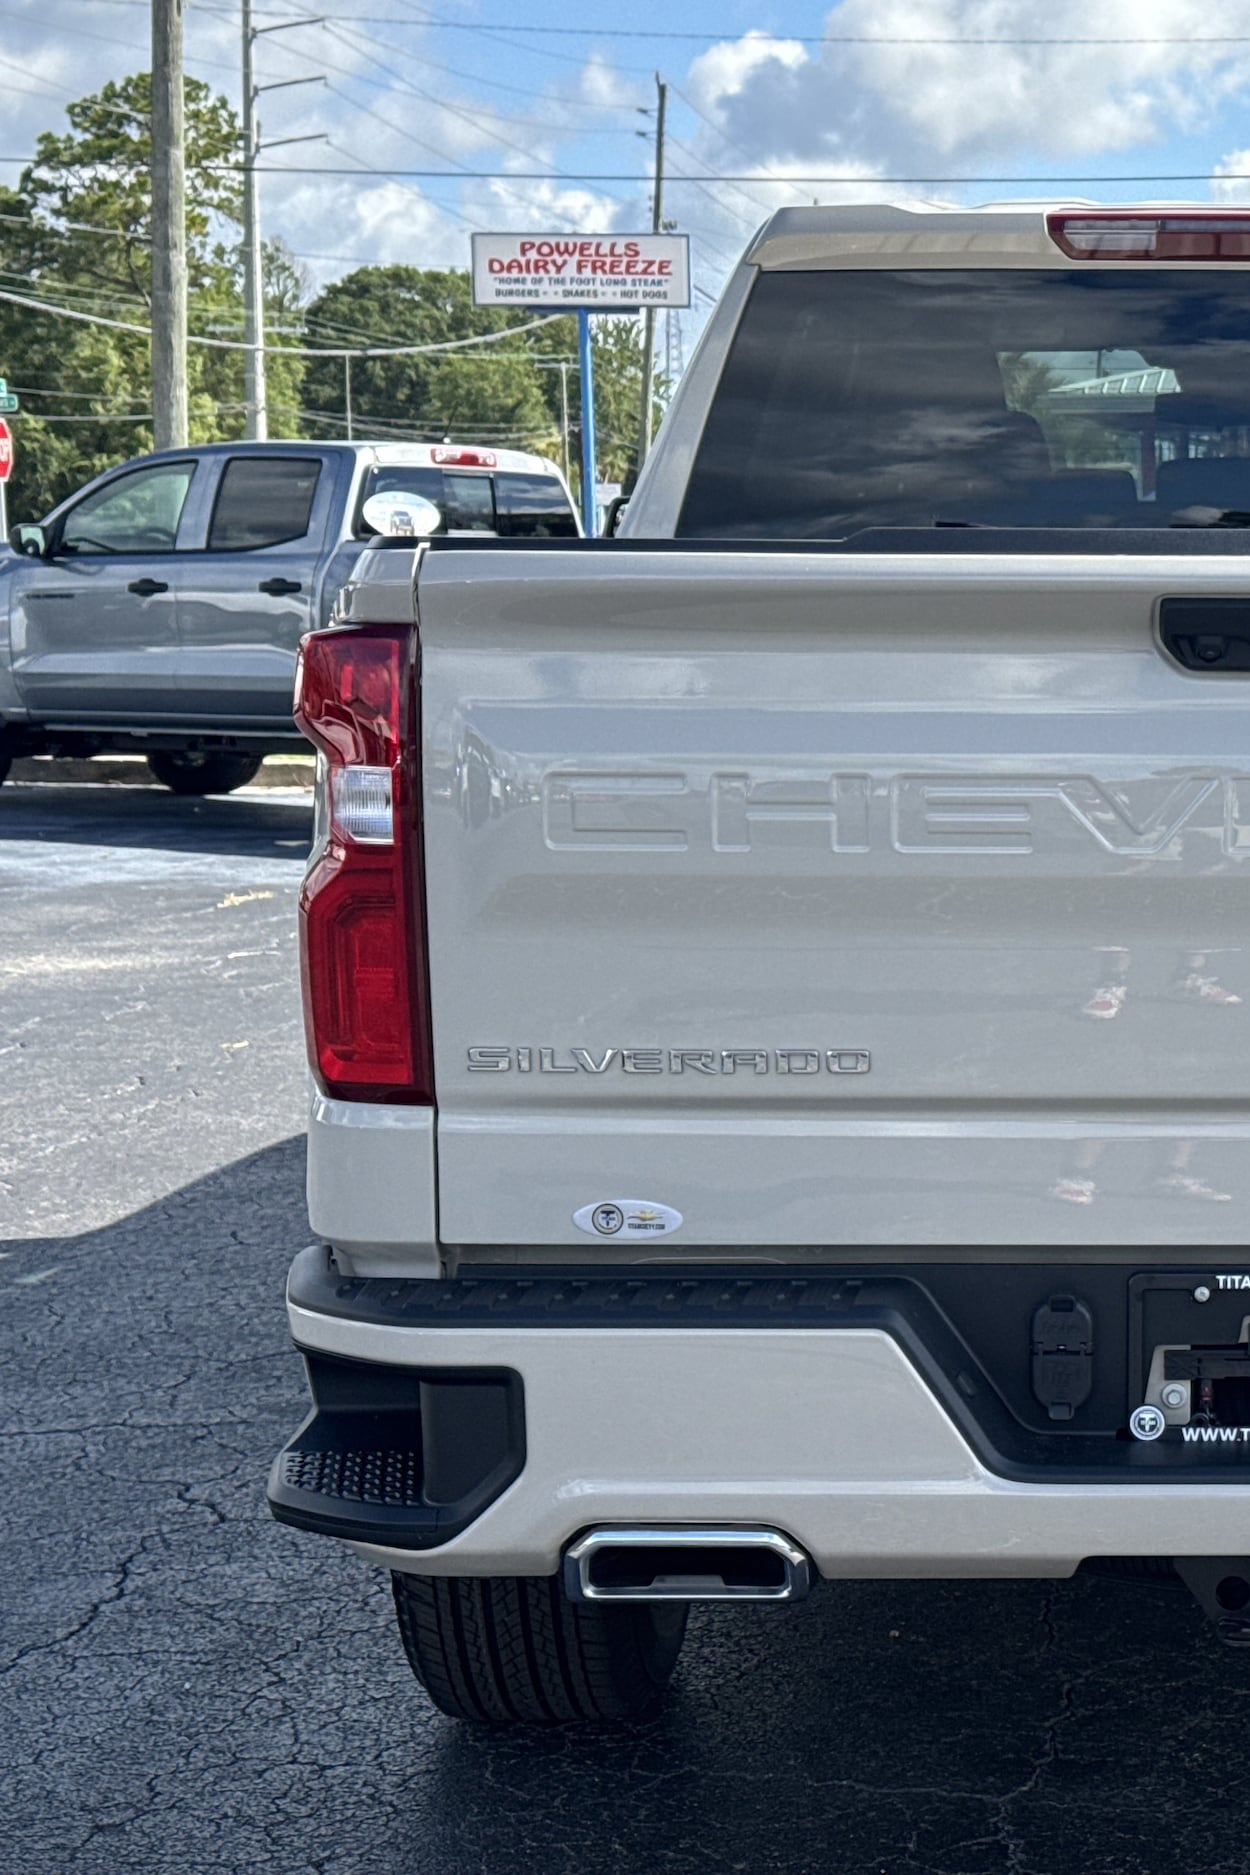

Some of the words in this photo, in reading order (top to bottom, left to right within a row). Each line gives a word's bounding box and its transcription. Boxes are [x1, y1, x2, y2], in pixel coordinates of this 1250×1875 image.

[519, 241, 641, 258] POWELLS
[488, 258, 568, 274] DAIRY
[576, 259, 673, 276] FREEZE
[530, 276, 544, 286] OF
[548, 276, 567, 287] THE
[569, 277, 597, 287] FOOT
[600, 277, 627, 287] LONG
[495, 288, 540, 298] BURGERS
[562, 288, 598, 299] SHAKES
[620, 289, 639, 299] HOT
[642, 290, 668, 300] DOGS
[467, 1046, 872, 1075] SILVERADO
